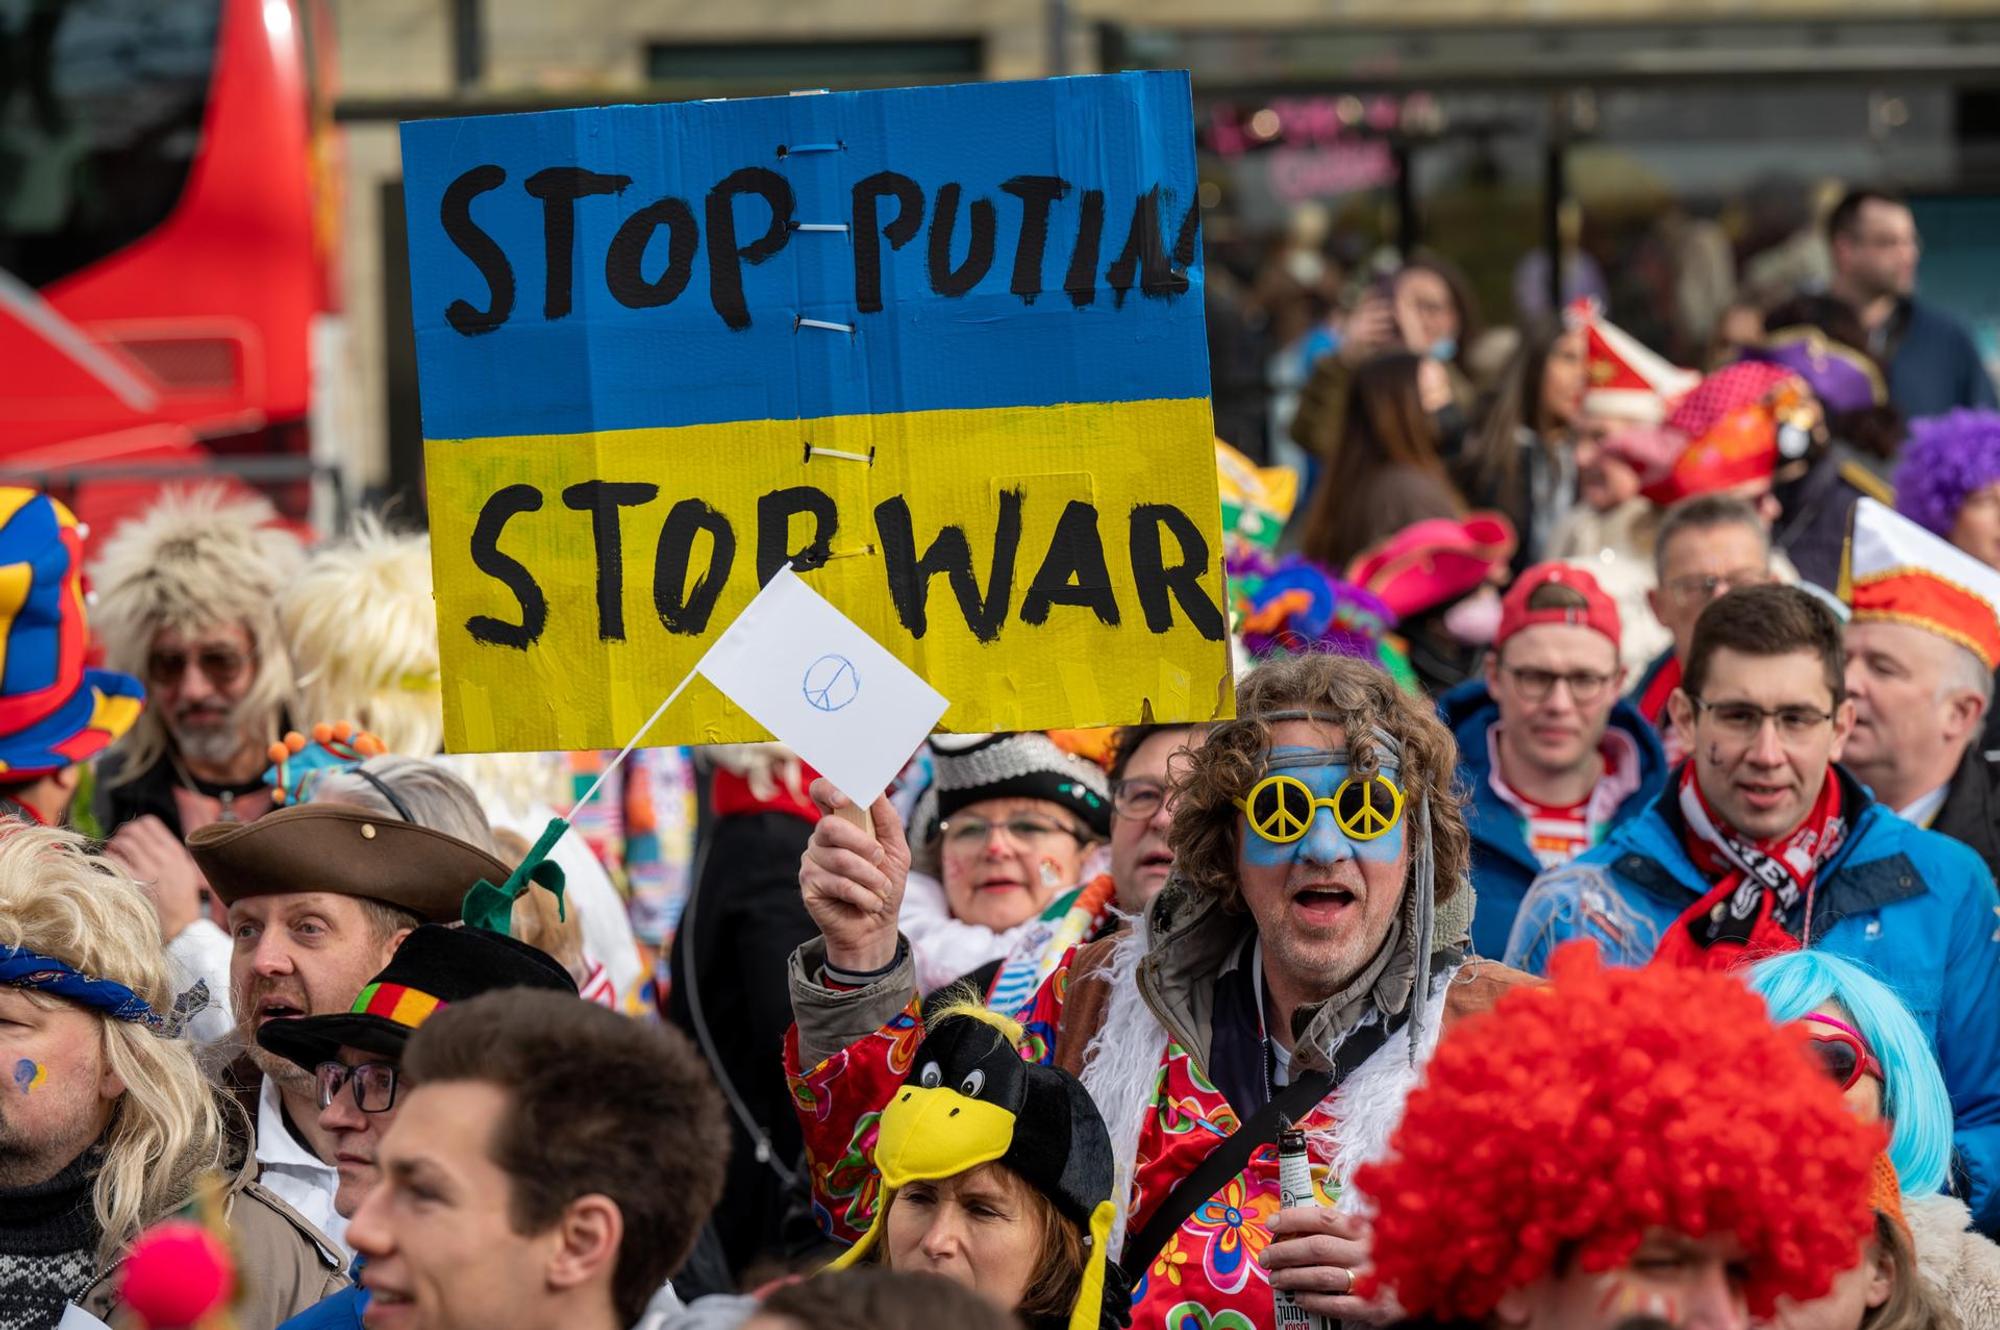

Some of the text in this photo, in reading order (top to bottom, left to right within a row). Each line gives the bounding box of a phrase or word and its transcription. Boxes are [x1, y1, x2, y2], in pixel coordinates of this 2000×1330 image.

[440, 164, 1199, 336] STOP PUTIN
[465, 481, 1226, 651] STOP WAR
